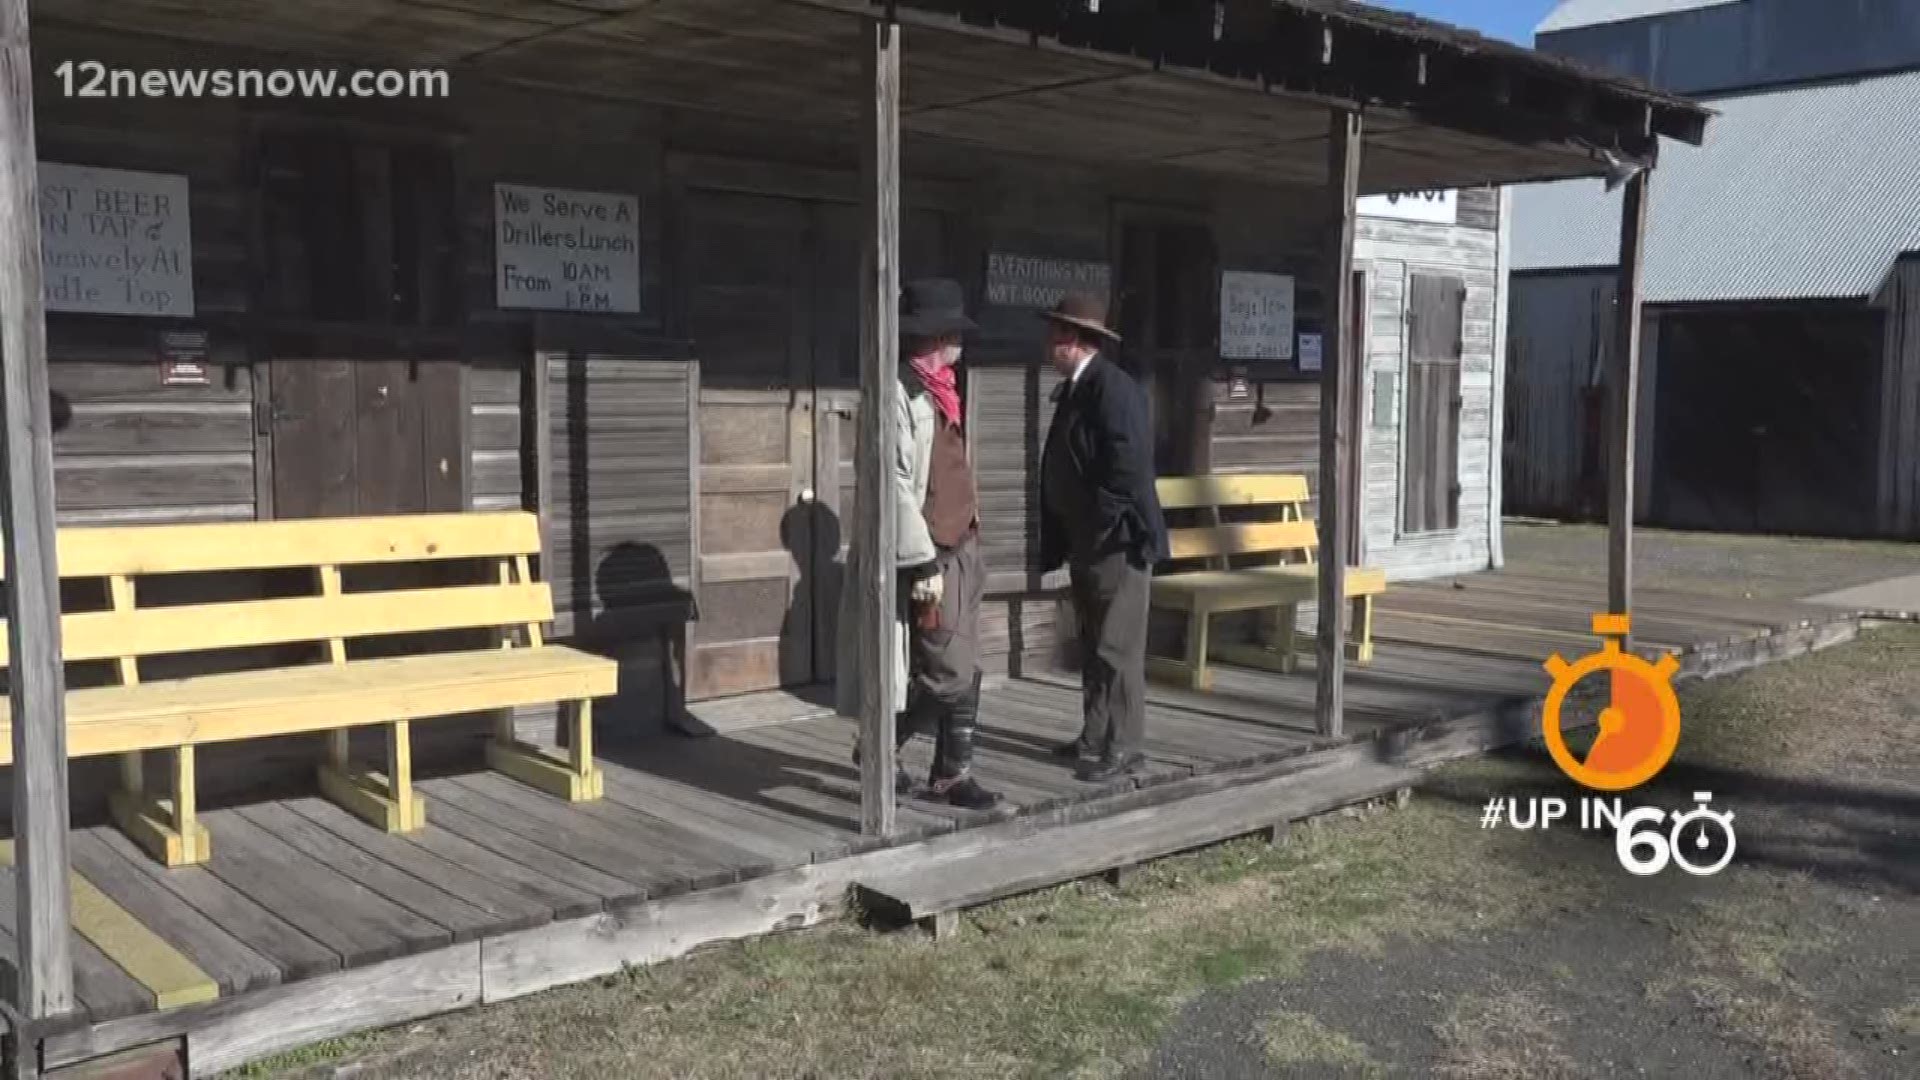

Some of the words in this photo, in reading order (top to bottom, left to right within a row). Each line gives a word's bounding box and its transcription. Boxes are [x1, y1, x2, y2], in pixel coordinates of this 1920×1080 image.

[95, 189, 171, 216] BEER
[500, 187, 530, 214] We
[543, 192, 608, 222] Serve
[615, 201, 631, 223] A
[82, 213, 138, 238] TAP
[503, 263, 552, 292] From
[116, 275, 172, 312] Top
